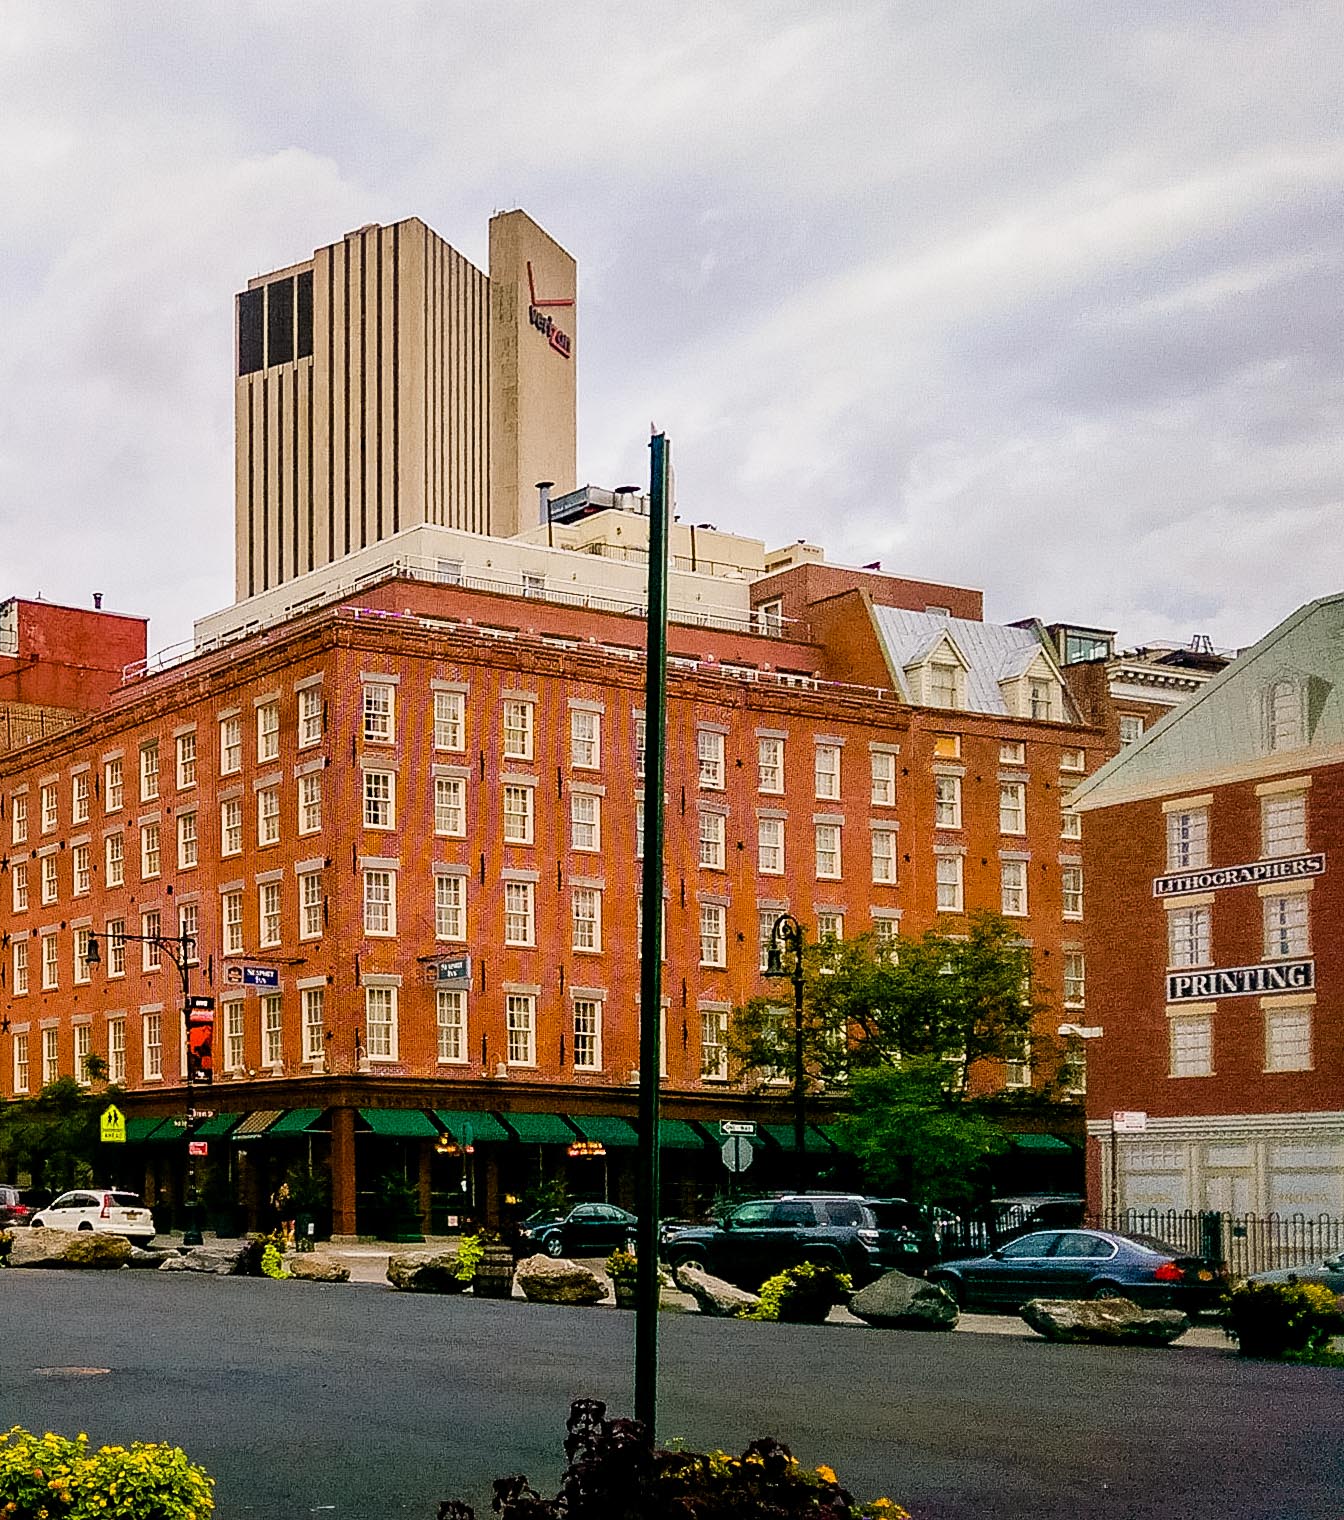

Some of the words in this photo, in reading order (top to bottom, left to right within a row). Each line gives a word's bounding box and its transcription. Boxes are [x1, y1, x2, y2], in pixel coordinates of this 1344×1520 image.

[529, 304, 571, 359] verizon
[1157, 858, 1321, 894] LITHOGRAPHERS
[1174, 965, 1306, 998] PRINTING
